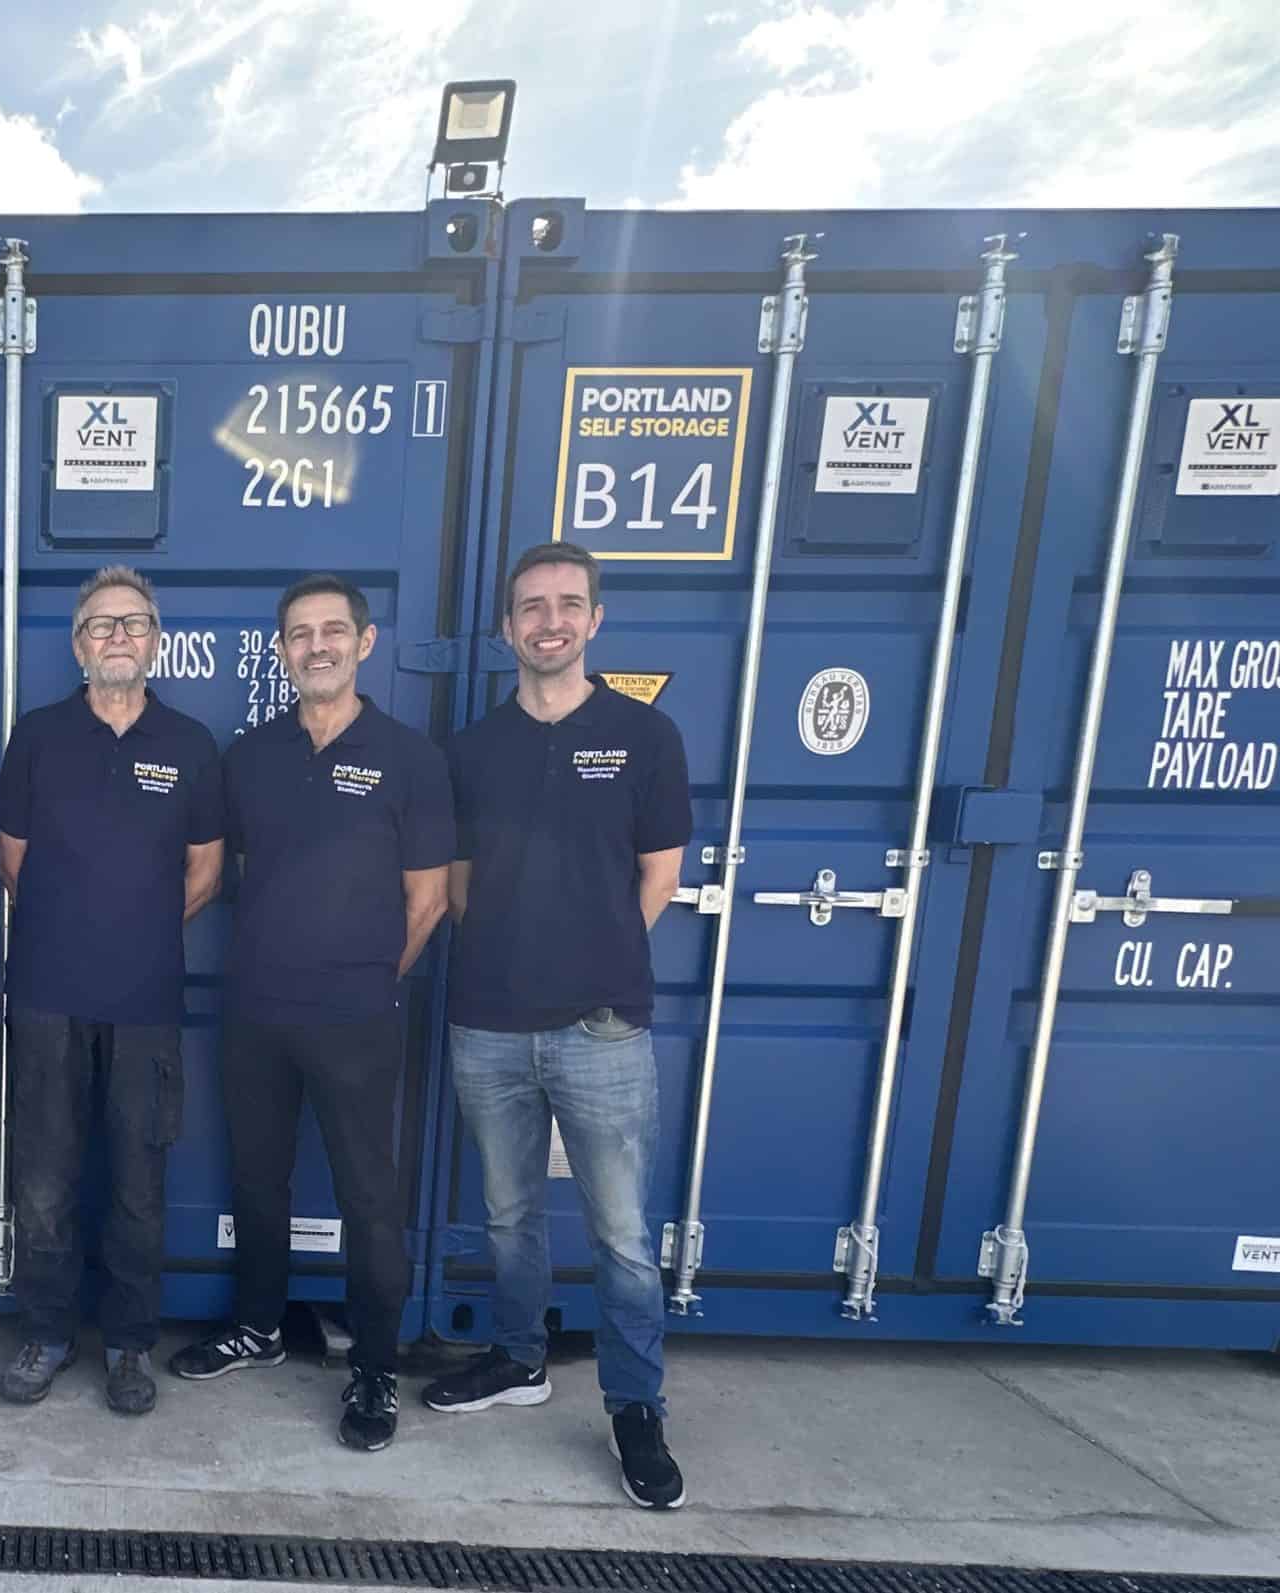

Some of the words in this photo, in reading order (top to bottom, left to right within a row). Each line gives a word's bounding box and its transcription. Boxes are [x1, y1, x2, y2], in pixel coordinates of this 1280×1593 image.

[249, 303, 346, 357] QUBU
[247, 385, 394, 434] 215665
[426, 384, 437, 433] 1
[581, 388, 732, 412] PORTLAND
[81, 402, 128, 430] XL
[579, 418, 626, 437] SELF
[630, 418, 729, 437] STORAGE
[848, 402, 896, 431] XL
[1211, 404, 1259, 432] XL
[77, 430, 136, 446] VENT
[843, 432, 905, 448] VENT
[1207, 433, 1270, 449] VENT
[242, 458, 334, 508] 22G1
[573, 463, 717, 529] B14
[1166, 640, 1225, 689] MAX
[1230, 640, 1280, 689] GRO
[1162, 692, 1232, 739] TARE
[134, 762, 179, 775] PORTLAND
[574, 750, 628, 759] PORTLAND
[1147, 742, 1277, 789] PAYLOAD
[334, 764, 382, 778] PORTLAND
[1115, 940, 1153, 987] CU.
[1176, 942, 1234, 989] CAP.
